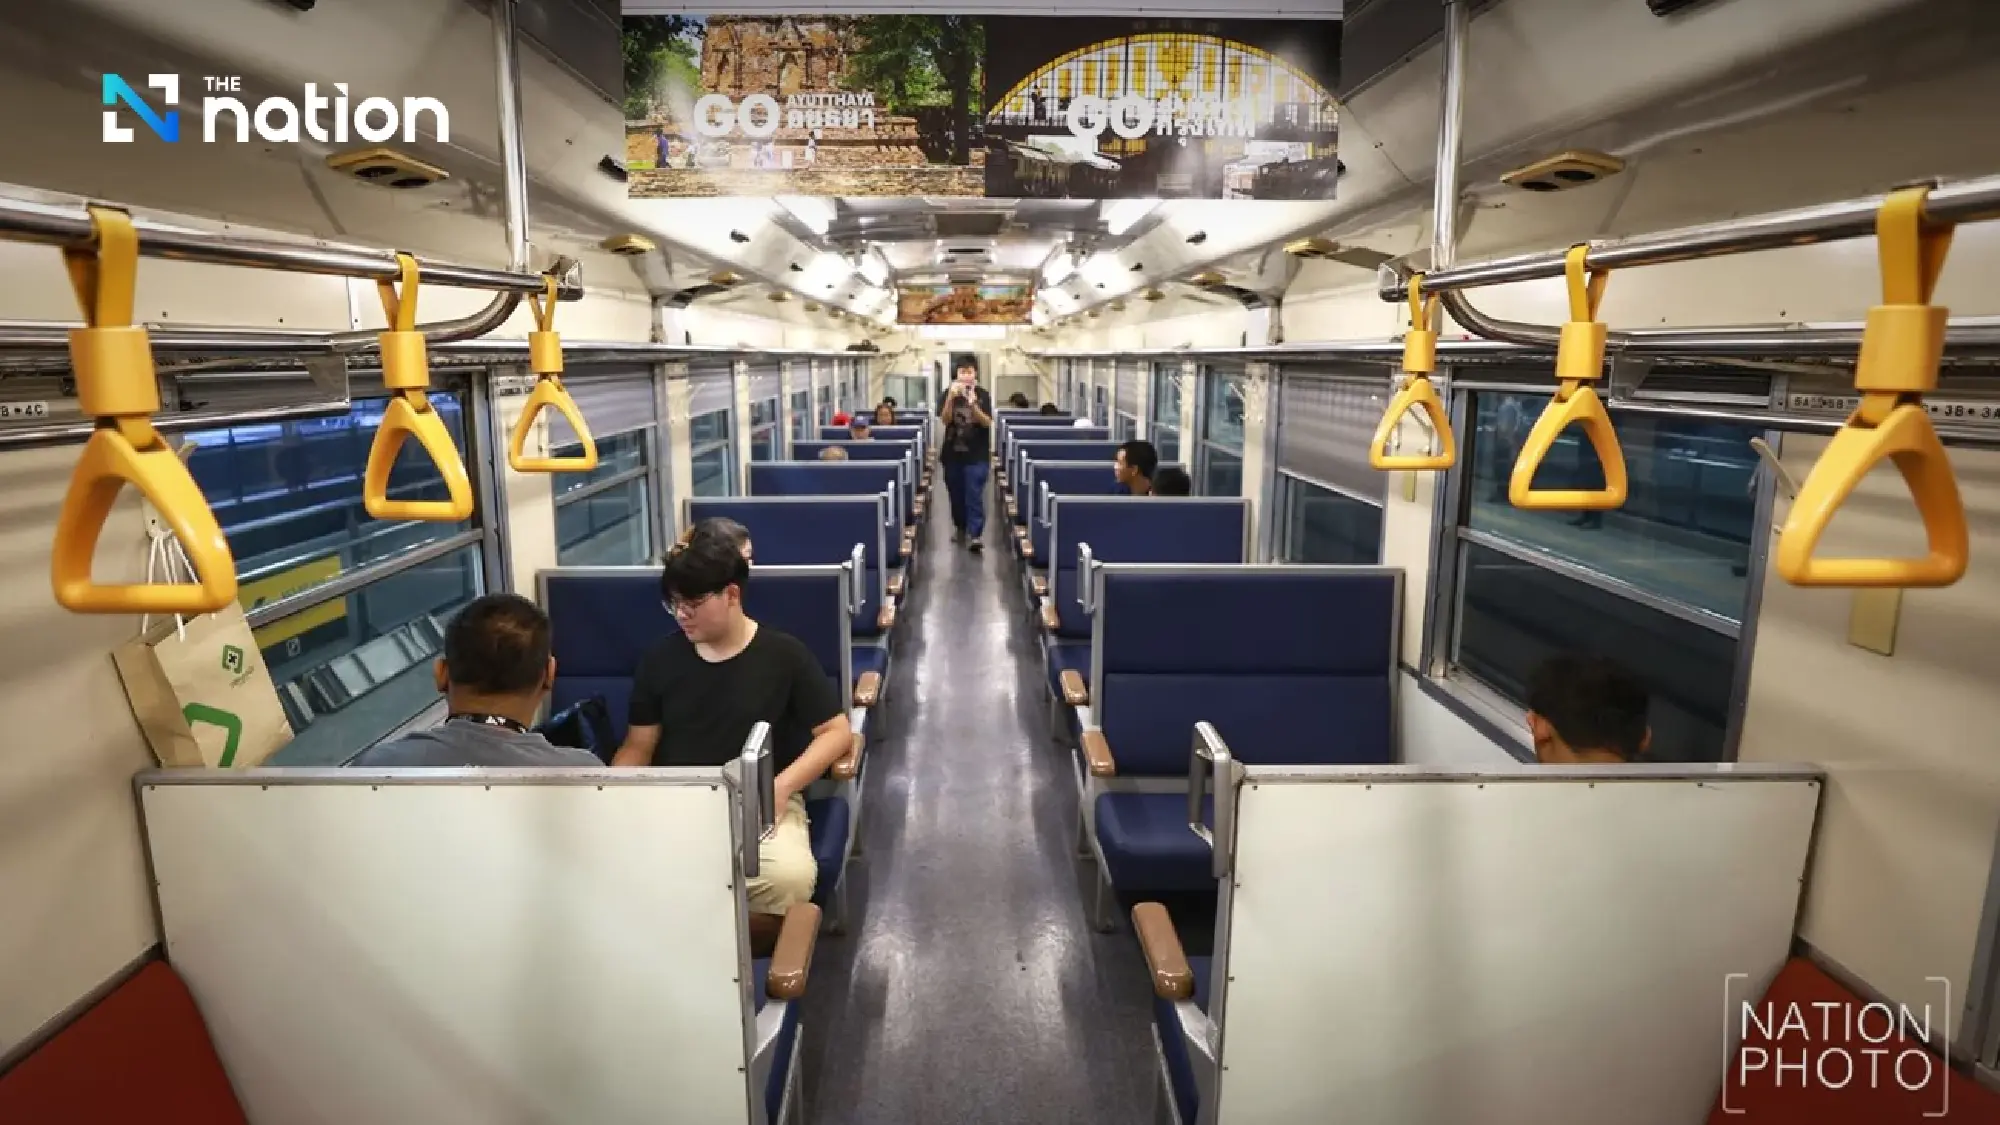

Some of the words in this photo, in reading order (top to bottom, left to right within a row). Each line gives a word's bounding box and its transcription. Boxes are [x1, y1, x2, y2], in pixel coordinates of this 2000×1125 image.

[694, 93, 780, 137] GO
[788, 91, 875, 107] AYUTTHAYA
[1067, 94, 1150, 138] GO
